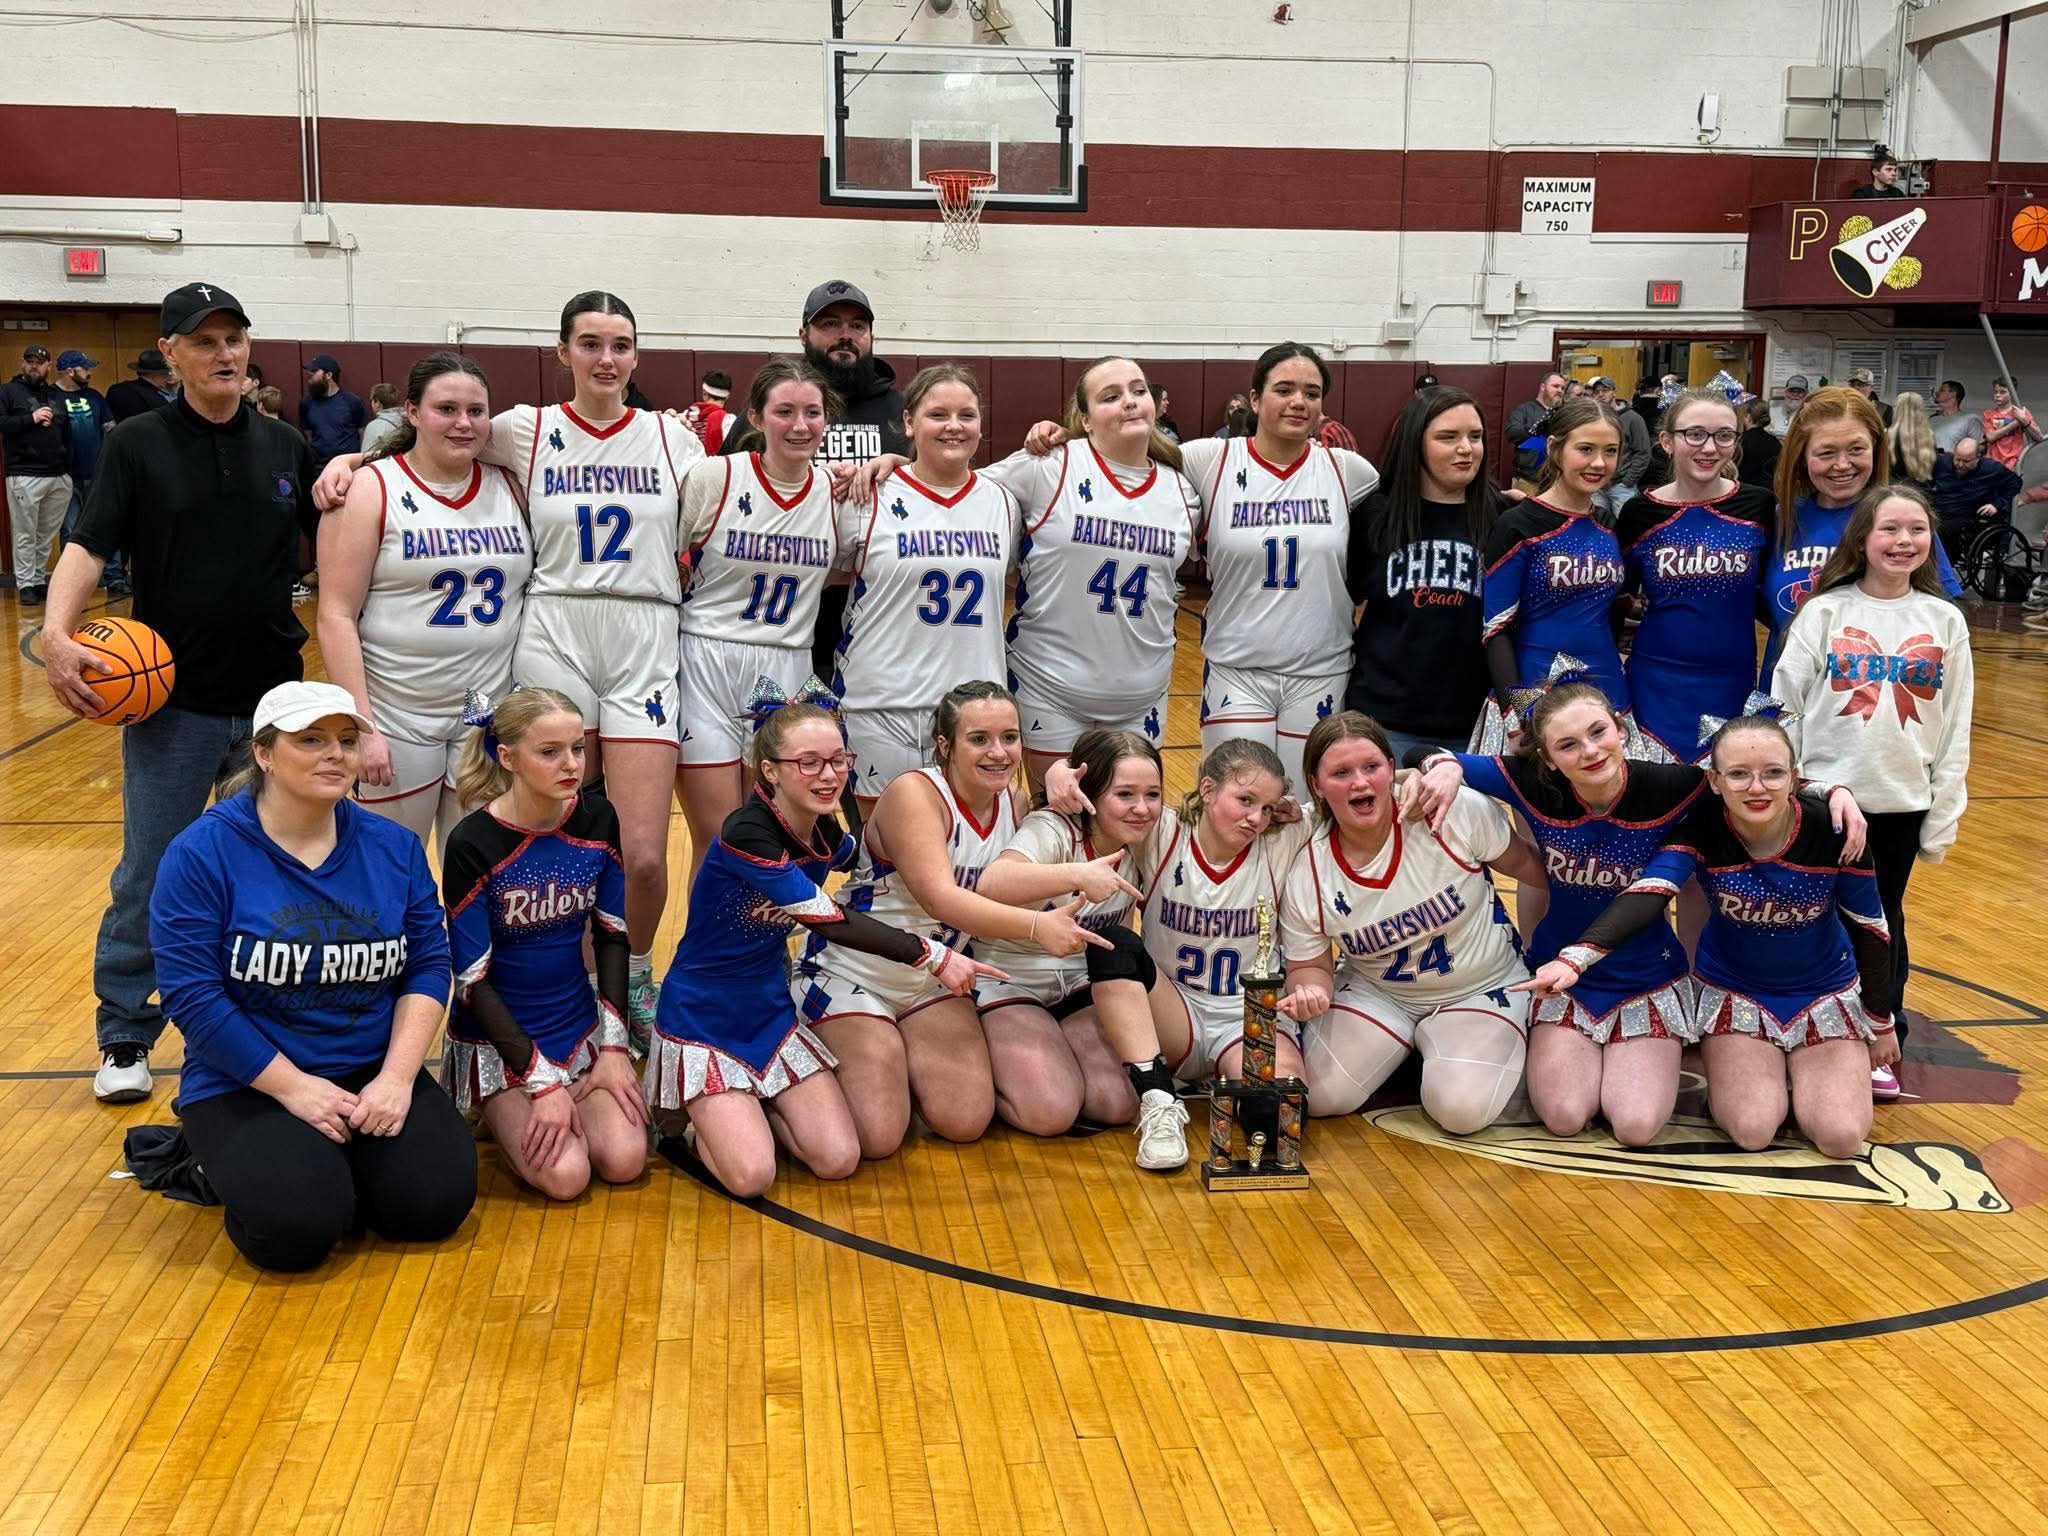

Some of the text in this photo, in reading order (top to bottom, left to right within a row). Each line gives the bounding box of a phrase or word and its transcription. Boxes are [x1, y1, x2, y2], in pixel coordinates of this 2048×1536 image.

[1524, 201, 1592, 212] CAPACITY
[1525, 182, 1591, 192] MAXIMUM
[1546, 221, 1568, 231] 750
[1790, 208, 1828, 260] P
[1866, 218, 1918, 264] CHEER
[1653, 284, 1678, 303] EXIT
[815, 431, 881, 458] EGEND
[544, 465, 662, 497] BAILEYSVILLE
[575, 503, 633, 564] 12
[1229, 498, 1333, 529] BAILEYSVILLE
[402, 525, 526, 560] BAILEYSVILLE
[724, 528, 829, 569] BAILEYSVILLE
[897, 529, 1002, 560] BAILEYSVILLE
[1070, 513, 1177, 558] BAILEYSVILLE
[1261, 535, 1301, 590] 11
[1548, 554, 1625, 588] Riders
[1655, 545, 1751, 578] Riders
[426, 565, 507, 627] 23
[738, 571, 800, 627] 10
[916, 568, 985, 627] 32
[1086, 557, 1151, 619] 44
[1412, 585, 1464, 608] Coach
[503, 882, 597, 926] Riders
[1159, 896, 1258, 938] BAILEYSVILL
[1340, 884, 1466, 956] BAILEYSVILLE
[1718, 891, 1827, 924] Riders
[230, 934, 408, 986] LADY RIDERS
[1175, 944, 1242, 996] 20
[1376, 933, 1454, 983] 24
